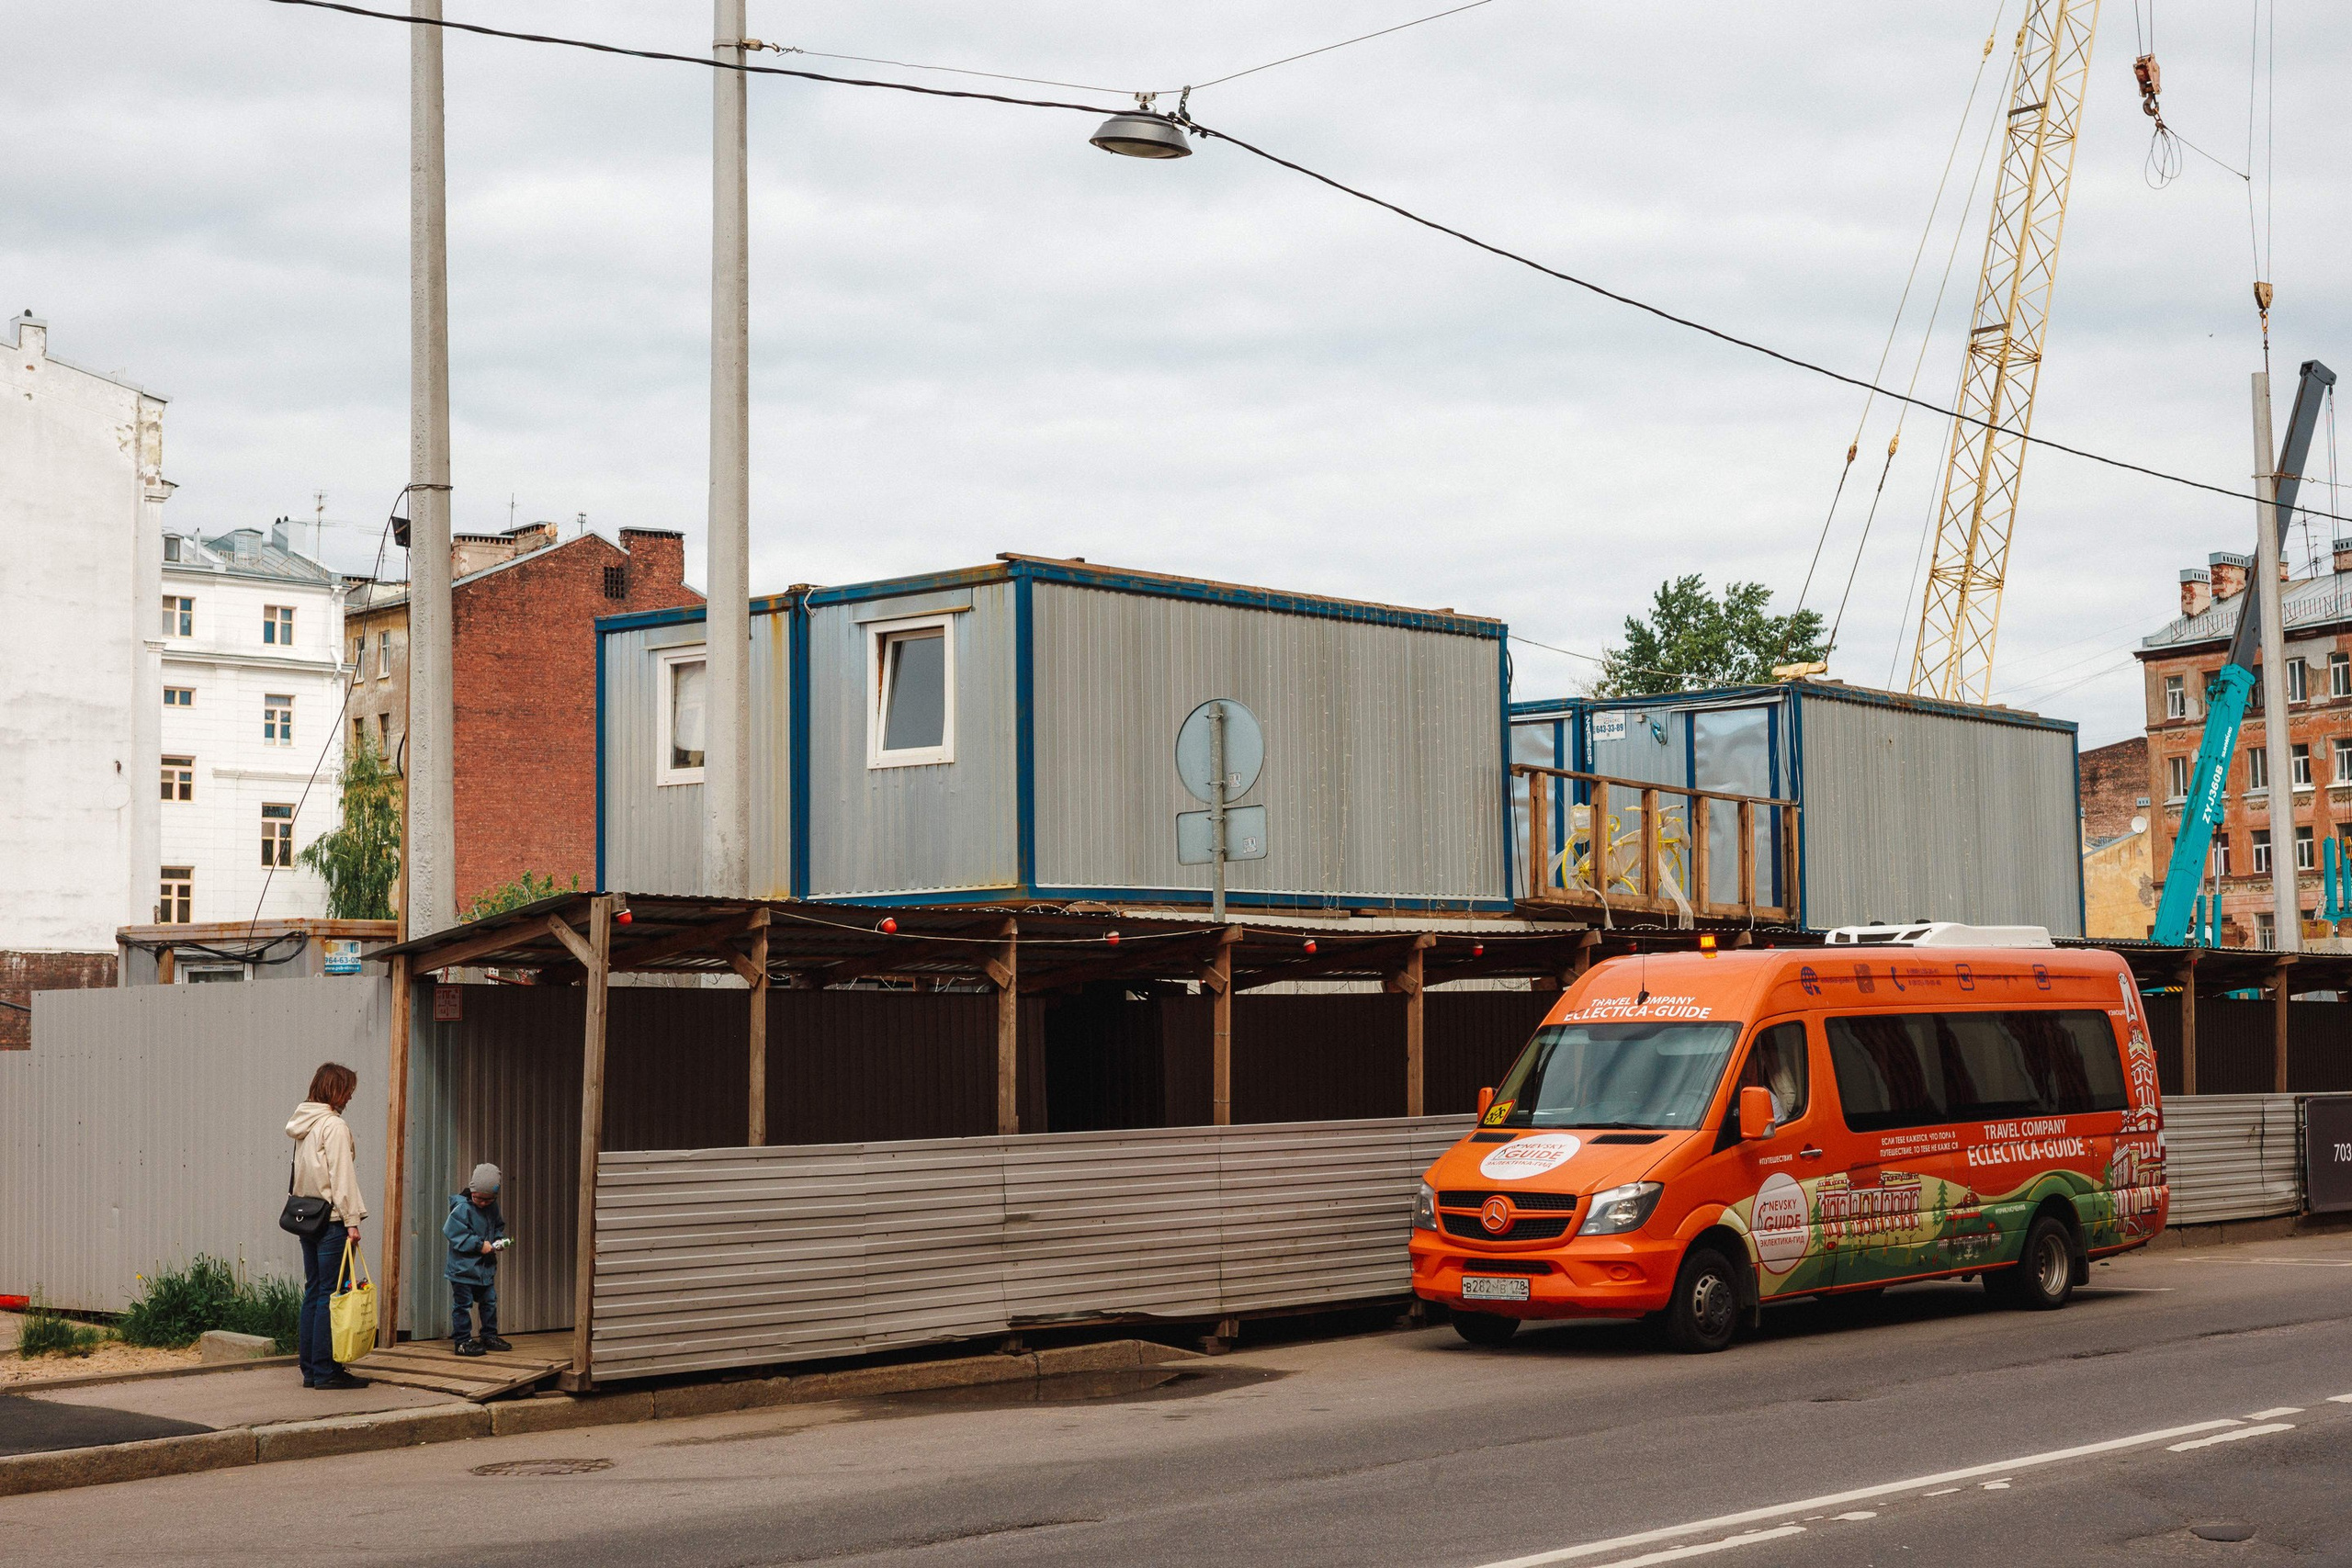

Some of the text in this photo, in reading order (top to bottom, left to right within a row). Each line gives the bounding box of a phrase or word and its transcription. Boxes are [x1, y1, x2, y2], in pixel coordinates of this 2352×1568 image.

[2202, 764, 2223, 824] ZYJ360B
[1590, 997, 1632, 1007] TRAVEL
[1563, 1005, 1713, 1022] ECLECTICA-GUIDE
[1984, 1119, 2066, 1140] TRAVEL COMPANY
[1882, 1137, 1895, 1145] ЕСЛИ
[1895, 1135, 1905, 1145] ТЕБЕ
[1929, 1133, 1939, 1141] ЧТО
[1939, 1132, 1951, 1140] ПОРА
[1505, 1150, 1565, 1160] GUIDE
[1914, 1145, 1920, 1154] ТО
[1921, 1145, 1930, 1153] ТЕБЕ
[1931, 1144, 1937, 1152] НЕ
[1967, 1136, 2086, 1167] ECLECTICA-GUIDE
[2334, 1143, 2352, 1162] 703
[1758, 1153, 1793, 1166] #ПУТЕШЕСТВИЯ
[1769, 1199, 1797, 1212] NEVSKY
[1764, 1213, 1802, 1232] GUIDE
[1759, 1235, 1805, 1247] ЭКЛЕКТИКА-ГИД
